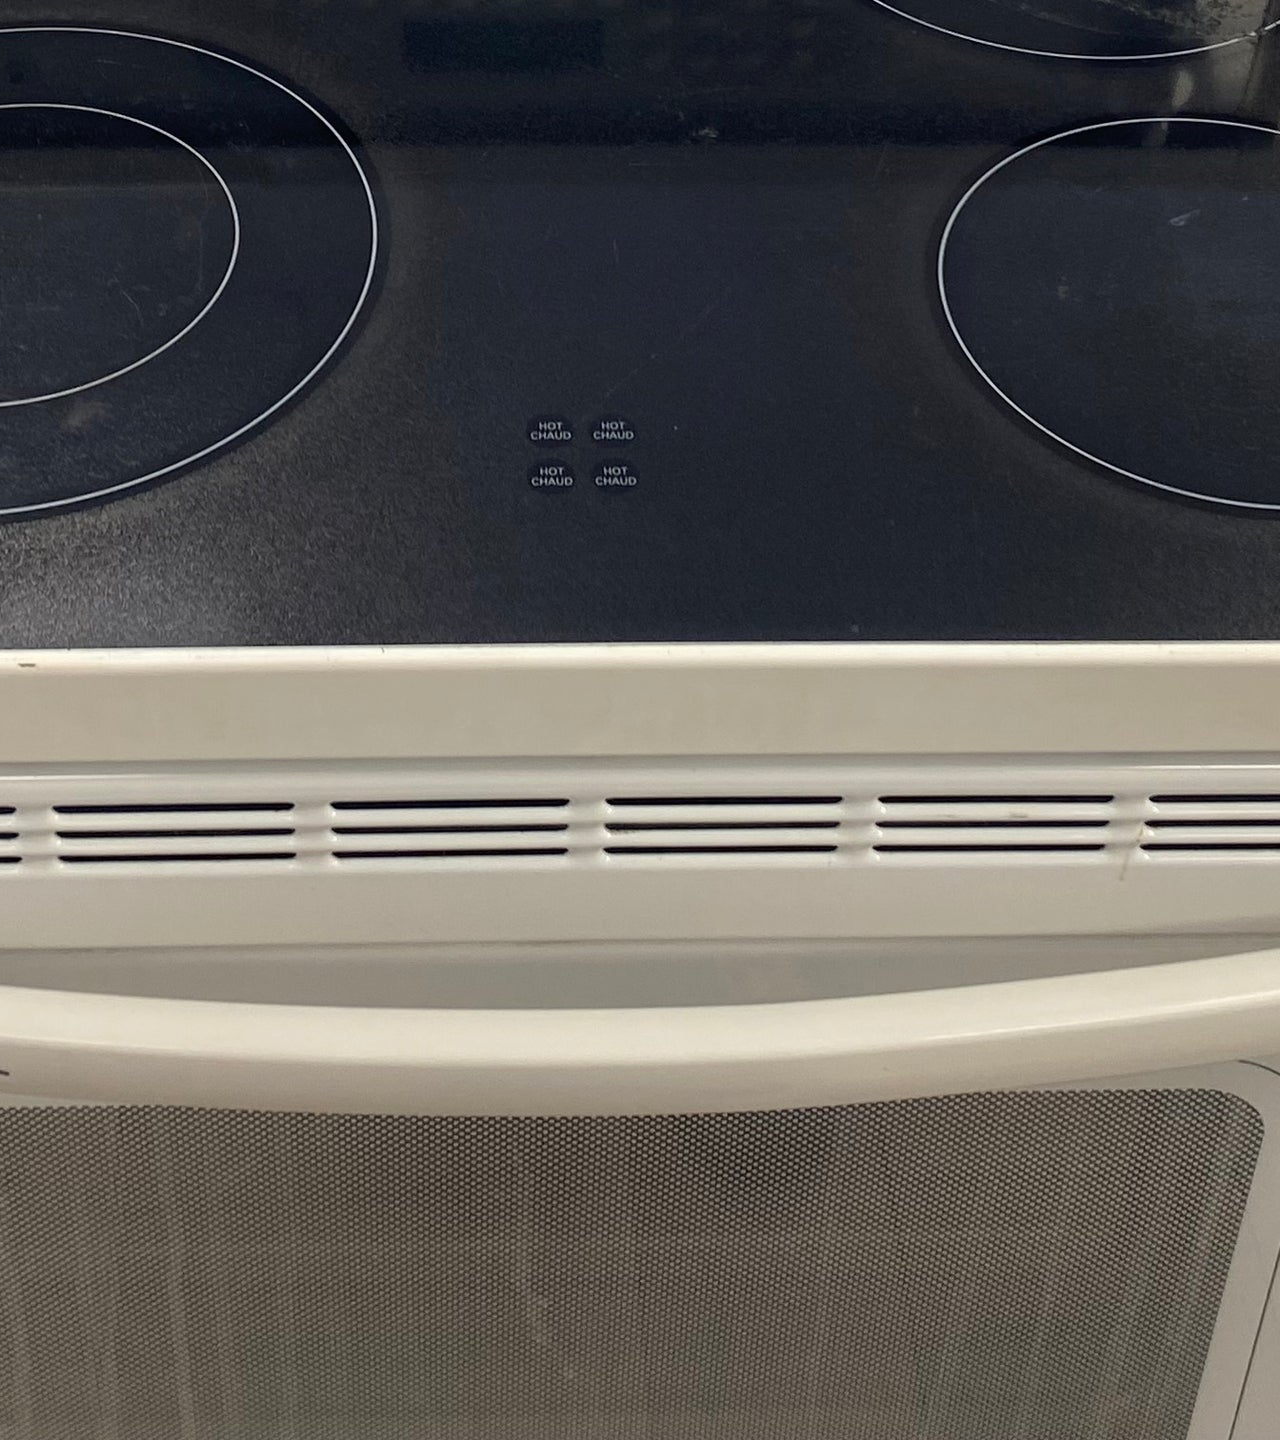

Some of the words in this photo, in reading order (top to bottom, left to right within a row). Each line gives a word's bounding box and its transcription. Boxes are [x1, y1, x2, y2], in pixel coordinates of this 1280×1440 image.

[538, 421, 563, 430] HOT
[601, 421, 626, 430] HOT
[530, 431, 572, 441] CHAUD
[593, 430, 635, 440] CHAUD
[540, 466, 564, 476] HOT
[603, 466, 628, 476] HOT
[531, 476, 573, 487] CHAUD
[595, 476, 637, 486] CHAUD
